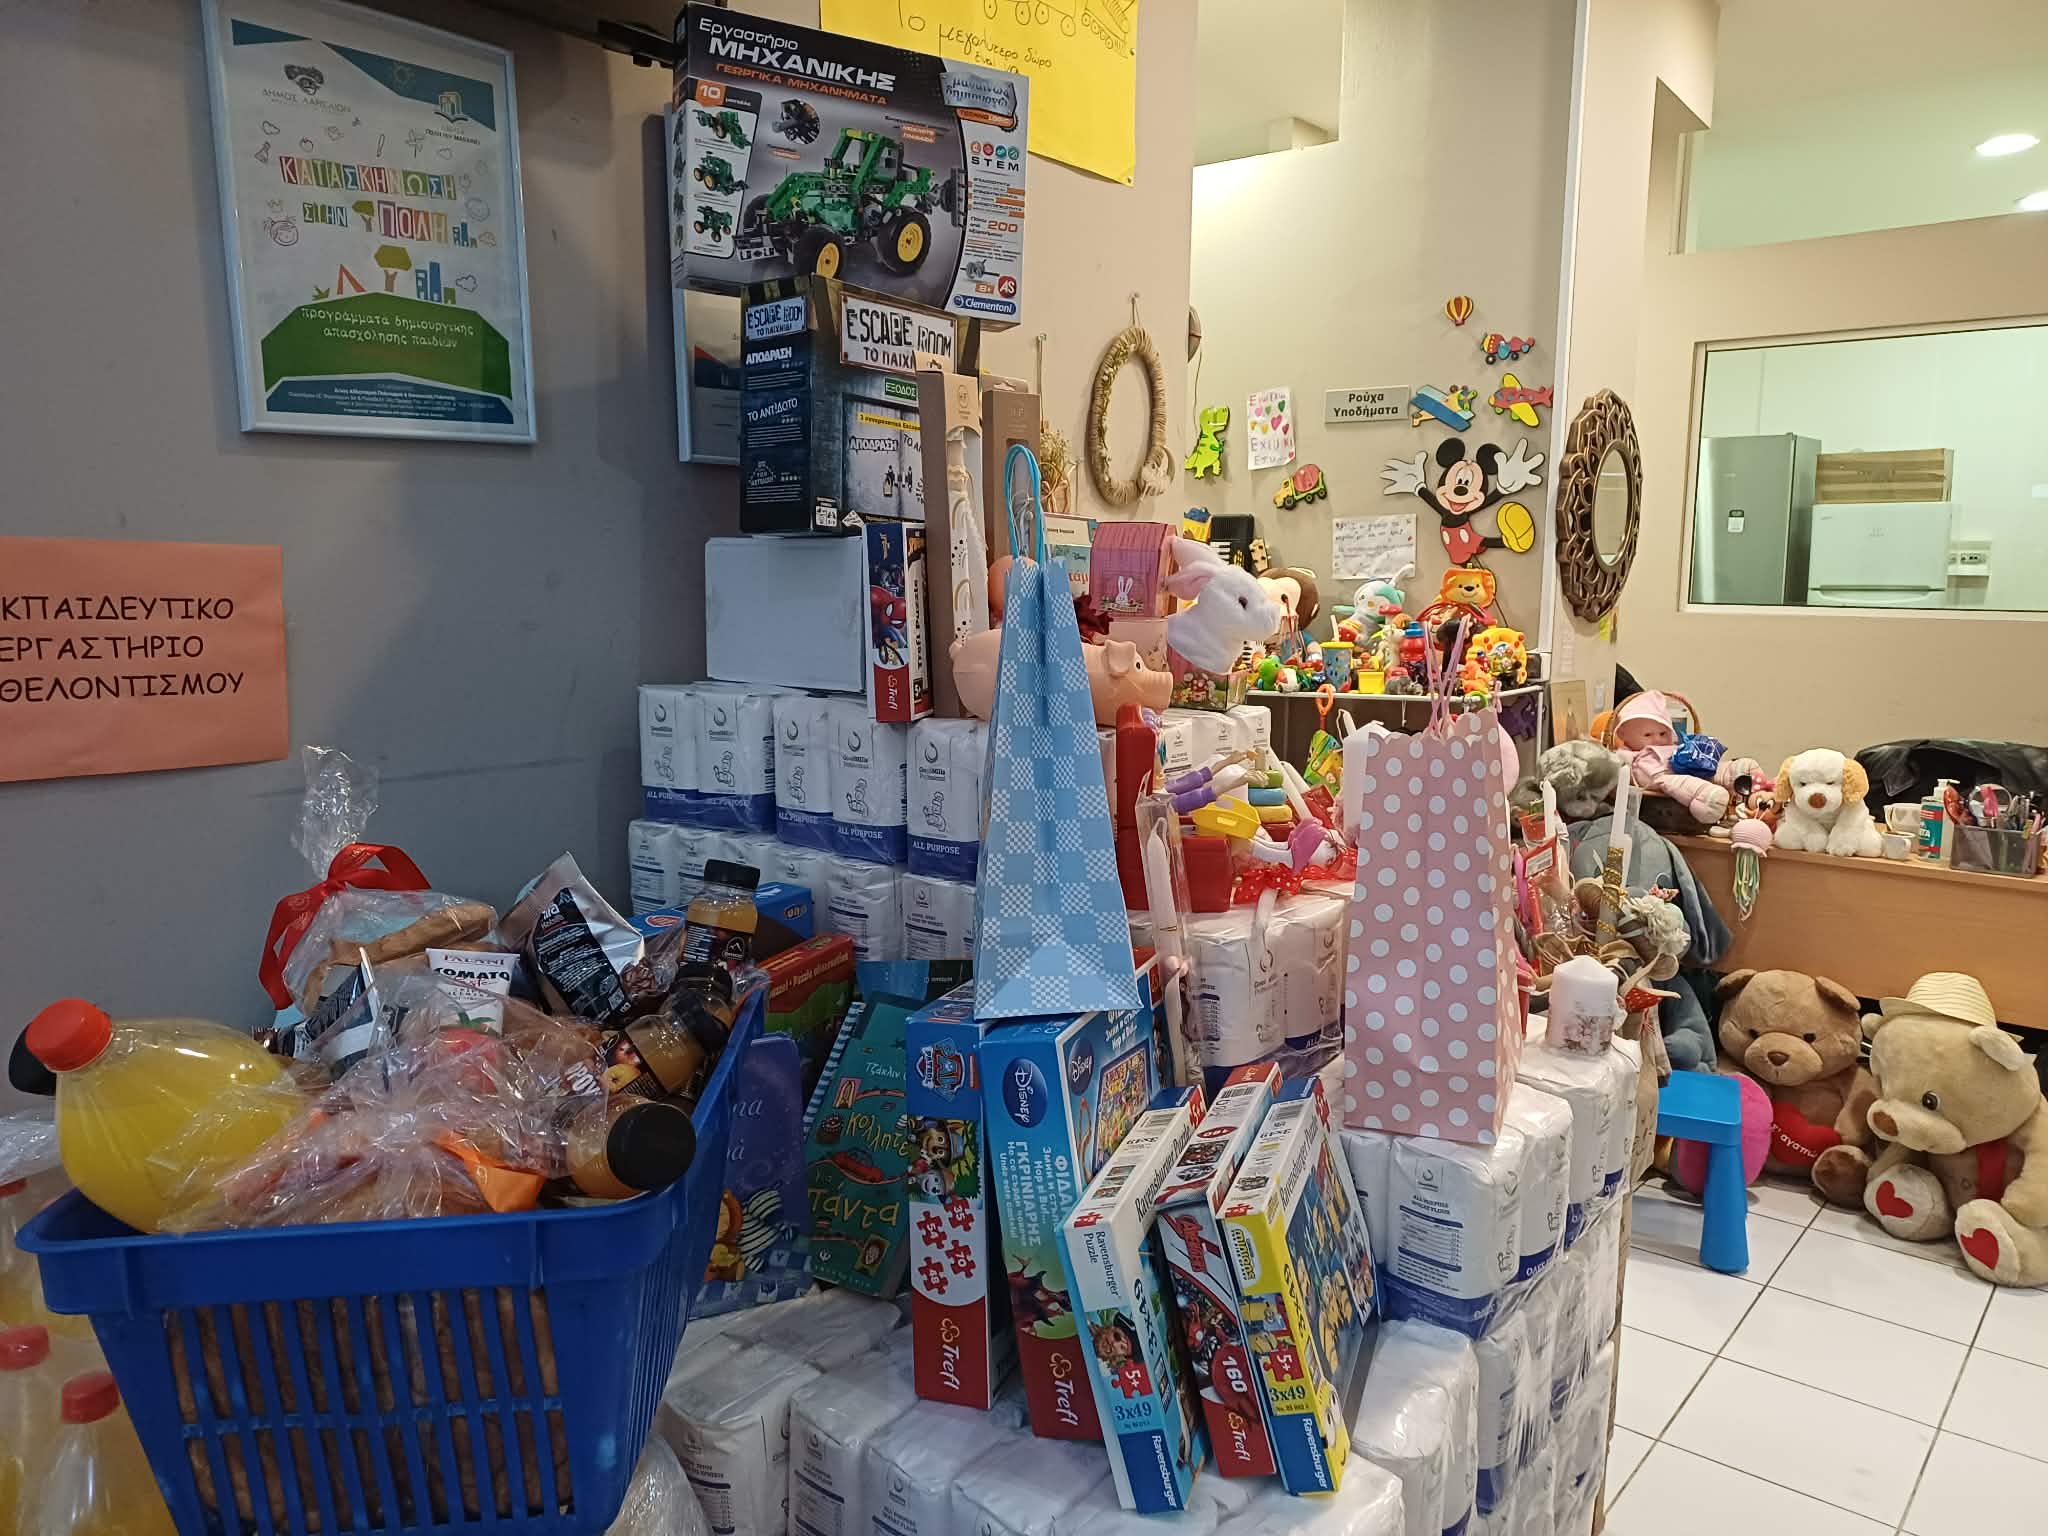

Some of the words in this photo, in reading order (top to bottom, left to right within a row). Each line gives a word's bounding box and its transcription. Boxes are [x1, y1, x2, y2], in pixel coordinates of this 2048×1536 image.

[699, 18, 798, 50] Εργαστήριο
[709, 38, 896, 92] ΜΗΧΑΝΙΚΗΣ
[701, 86, 721, 98] 10
[716, 63, 783, 85] ΓΕΩΡΓΙΚΑ
[787, 78, 888, 105] ΜΗΧΑΝΗΜΑΤΑ
[971, 156, 1019, 171] STEM
[281, 157, 457, 200] ΚΑΤΑΣΚΗΝΩΣΗ
[303, 203, 348, 227] ΣΤΗΝ
[379, 202, 448, 243] ΠΟΛΗ
[987, 220, 1018, 232] 200
[1000, 280, 1015, 294] AS
[965, 297, 1012, 314] Clementoni
[747, 303, 781, 329] ESCAPE
[783, 305, 803, 322] ROOM
[846, 308, 912, 347] ESCAPE
[917, 325, 951, 358] ROOM
[745, 346, 793, 365] ΑΠΟΔΡΑΣΗ
[863, 346, 879, 362] ΤΟ
[885, 382, 916, 397] ΕΞΟΔΟΣ
[1349, 391, 1384, 404] Ρούχα
[748, 411, 758, 422] ΤΟ
[1333, 405, 1399, 418] Υποδήματα
[850, 436, 899, 453] ΑΠΟΔΡΑΣΗ
[1, 595, 234, 621] ΚΠΑΙΔΕΥΤΙΚΟ
[0, 635, 204, 662] ΕΡΓΑΣΤΗΡΙΟ
[0, 672, 244, 702] ΘΕΛΟΝΤΙΣΜΟΥ
[886, 685, 898, 711] Trefl
[838, 826, 849, 835] ALL
[851, 829, 883, 839] PURPOSE
[913, 840, 925, 850] ALL
[926, 844, 960, 855] PURPOSE
[433, 967, 510, 982] TOMATO
[1016, 1141, 1041, 1247] ΓΚΡΙΝΙΑΡΗΣ
[1134, 1152, 1175, 1222] Ravensburger
[952, 1206, 966, 1222] 35
[926, 1222, 939, 1240] 54
[1084, 1232, 1098, 1264] Puzzle
[955, 1250, 966, 1268] 70
[1096, 1231, 1120, 1297] Ravensburger
[928, 1269, 941, 1286] 48
[942, 1344, 960, 1391] Trefl
[1276, 1354, 1293, 1372] 5+
[1125, 1368, 1142, 1387] 5+
[1221, 1356, 1248, 1393] 160
[1054, 1380, 1080, 1426] Trefl
[1270, 1385, 1306, 1402] 3x49
[1114, 1401, 1152, 1421] 3x49
[1231, 1428, 1251, 1461] Trefl
[1302, 1418, 1328, 1489] Ravensburger
[1151, 1435, 1177, 1509] Ravensburger
